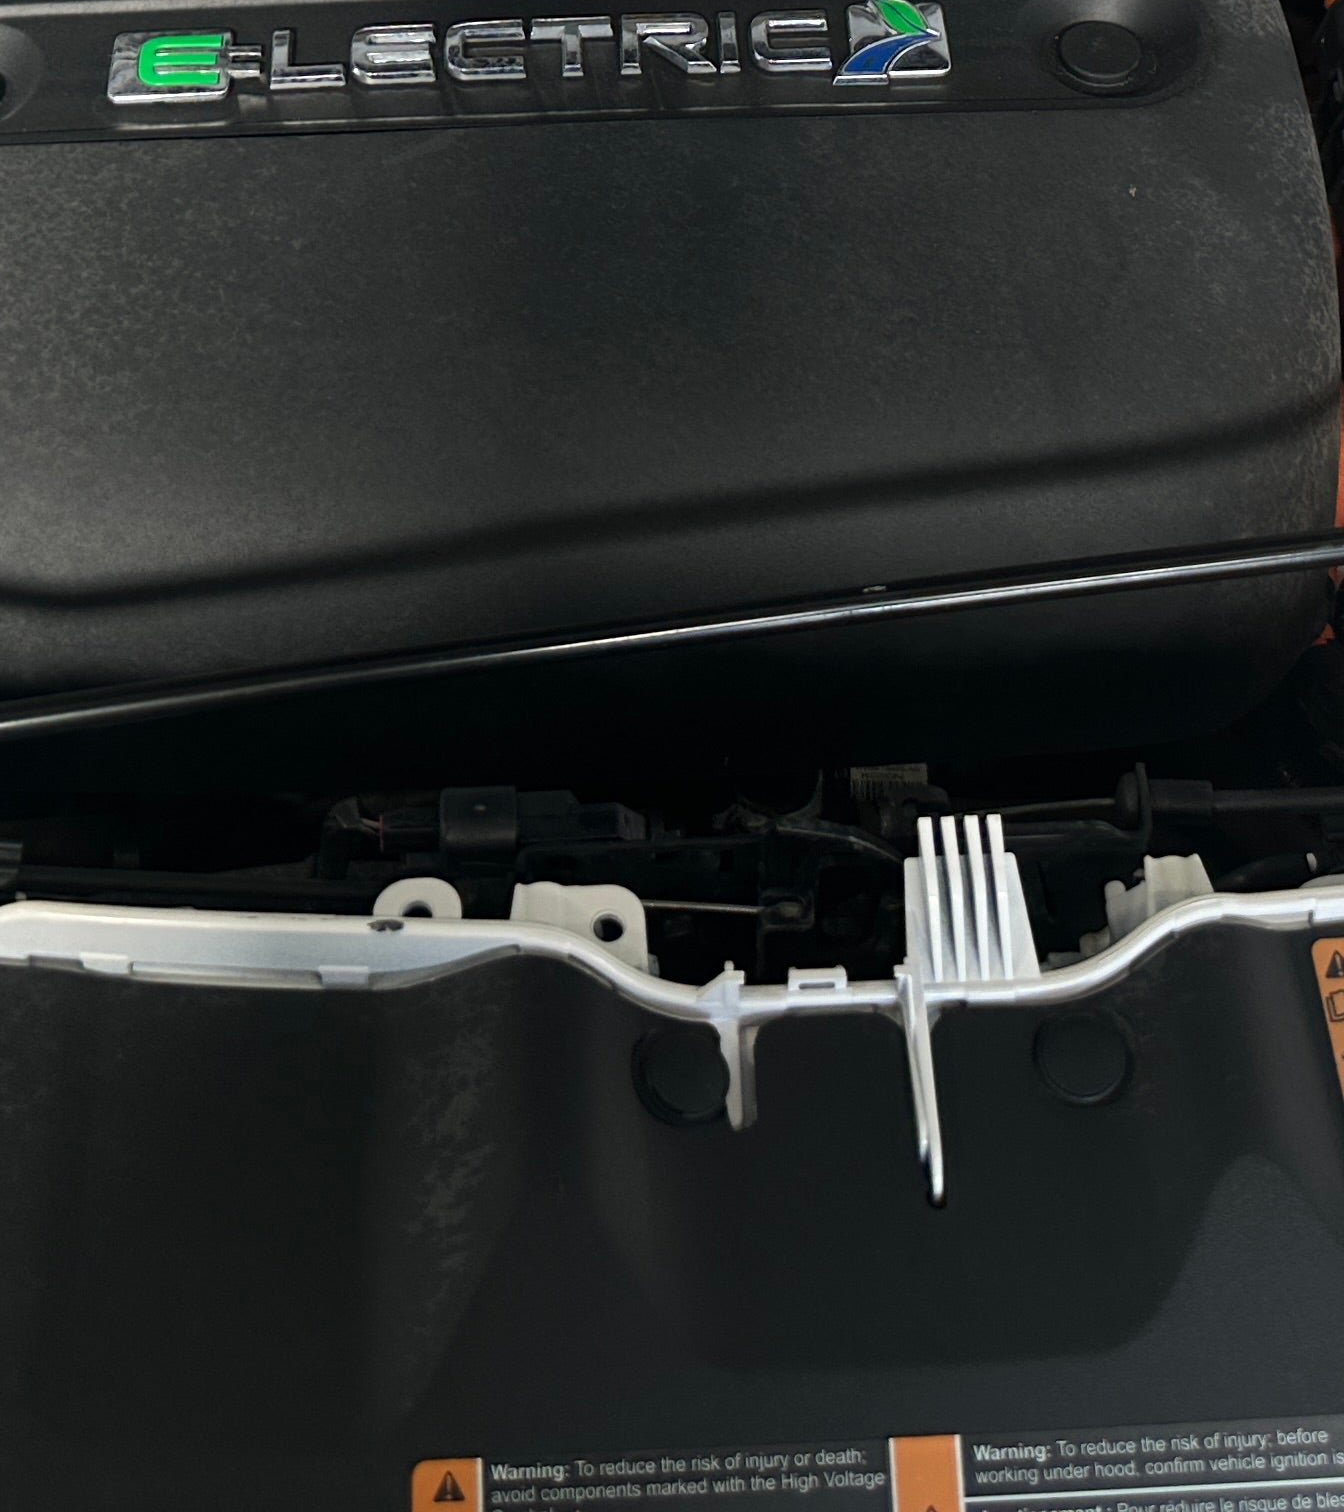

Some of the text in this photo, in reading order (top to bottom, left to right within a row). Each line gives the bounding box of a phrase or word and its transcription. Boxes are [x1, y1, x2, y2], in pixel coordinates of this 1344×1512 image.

[972, 1442, 1052, 1463] Warning:
[1056, 1439, 1076, 1457] To
[1080, 1438, 1137, 1455] reduce
[1141, 1436, 1166, 1452] the
[1171, 1434, 1200, 1451] risk
[1203, 1431, 1220, 1449] of
[1276, 1427, 1329, 1445] before
[490, 1463, 571, 1482] Warning:
[574, 1459, 595, 1476] To
[599, 1459, 656, 1475] reduce
[660, 1456, 687, 1472] the
[691, 1454, 720, 1471] risk
[724, 1452, 742, 1470] of
[745, 1451, 789, 1472] injury
[793, 1452, 812, 1466] or
[975, 1466, 1039, 1485] working
[1043, 1463, 1090, 1479] under
[1144, 1456, 1205, 1474] confirm
[1209, 1452, 1266, 1470] vehicle
[1270, 1450, 1328, 1472] ignition
[1332, 1448, 1344, 1464] is
[490, 1469, 886, 1504] avoid components marked with the High Voltage
[1219, 1498, 1238, 1512] le
[1239, 1495, 1288, 1512] risque
[1291, 1492, 1312, 1509] de
